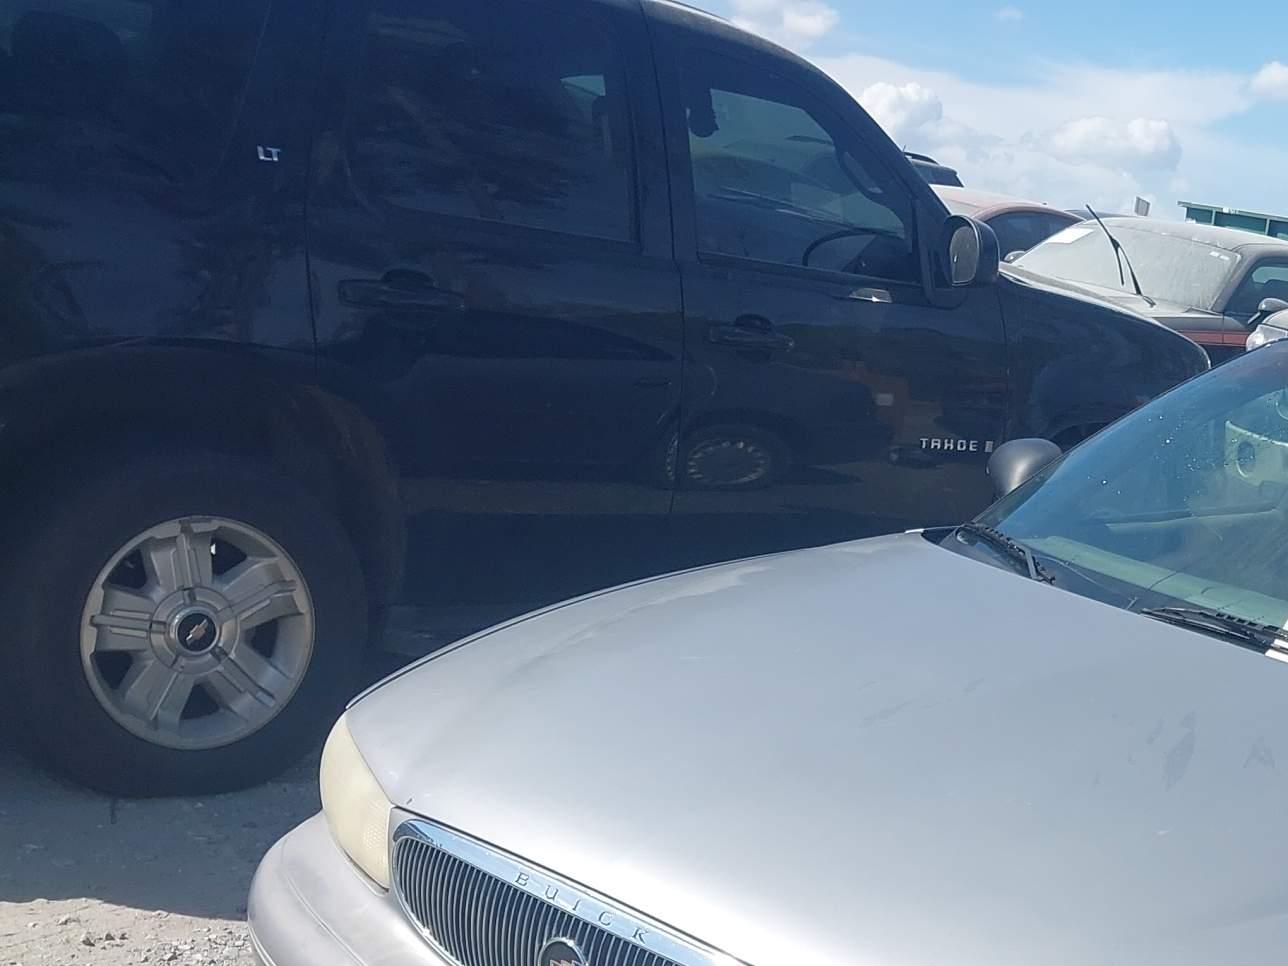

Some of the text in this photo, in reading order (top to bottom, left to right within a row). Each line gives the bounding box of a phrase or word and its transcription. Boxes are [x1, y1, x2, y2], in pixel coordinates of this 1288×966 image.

[257, 145, 281, 161] LT
[920, 438, 978, 452] TAHOE
[514, 871, 649, 944] BUICK
